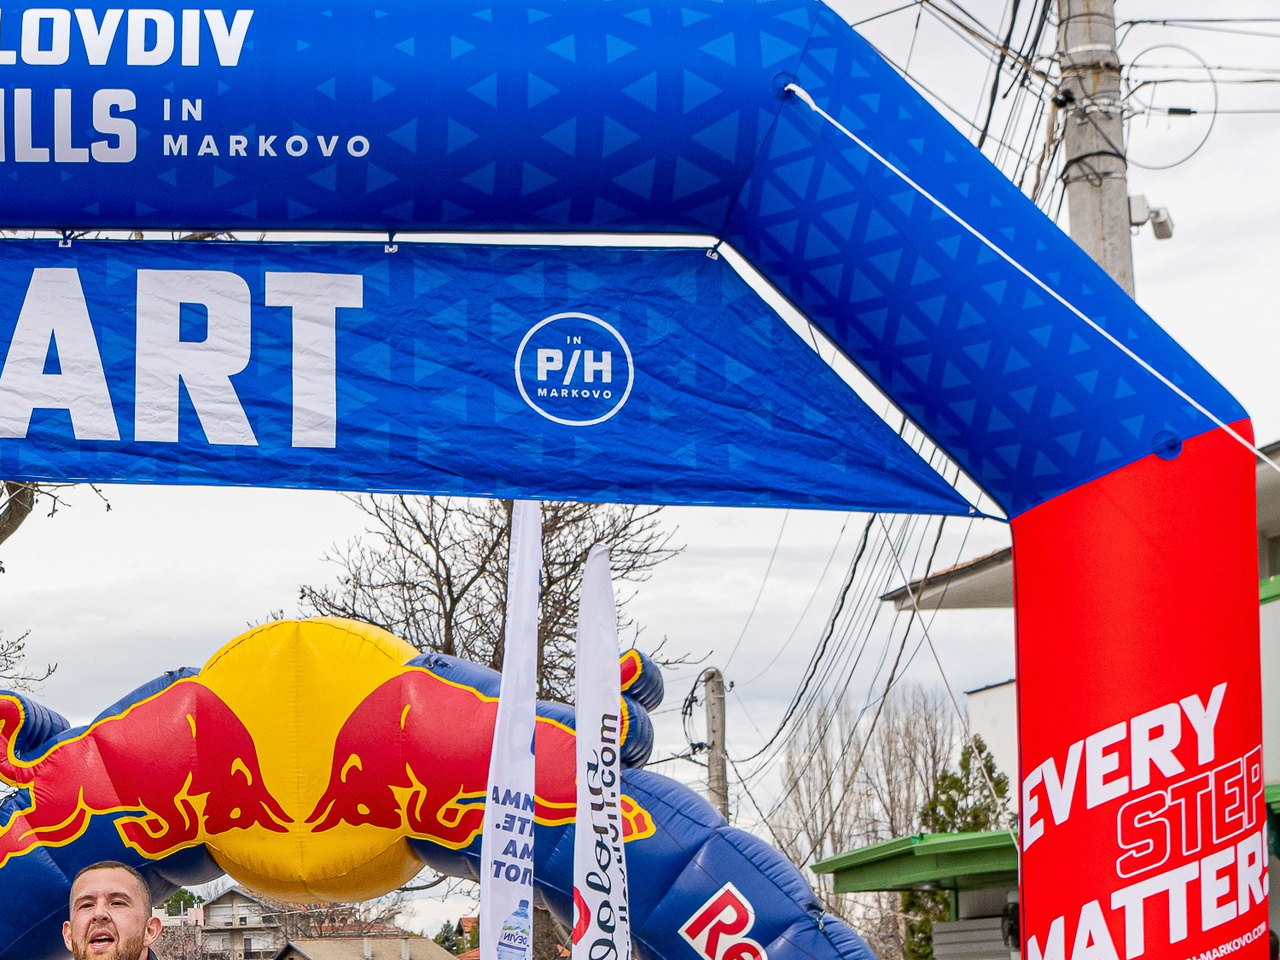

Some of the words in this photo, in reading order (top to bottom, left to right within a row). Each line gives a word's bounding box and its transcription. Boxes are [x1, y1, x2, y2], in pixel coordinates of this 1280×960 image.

[162, 98, 203, 122] IN
[162, 135, 371, 158] MARKOVO
[566, 335, 583, 345] IN
[537, 348, 612, 386] P/H
[537, 387, 613, 400] MARKOVO
[1023, 682, 1227, 852] EVERY
[1116, 744, 1264, 878] STEP
